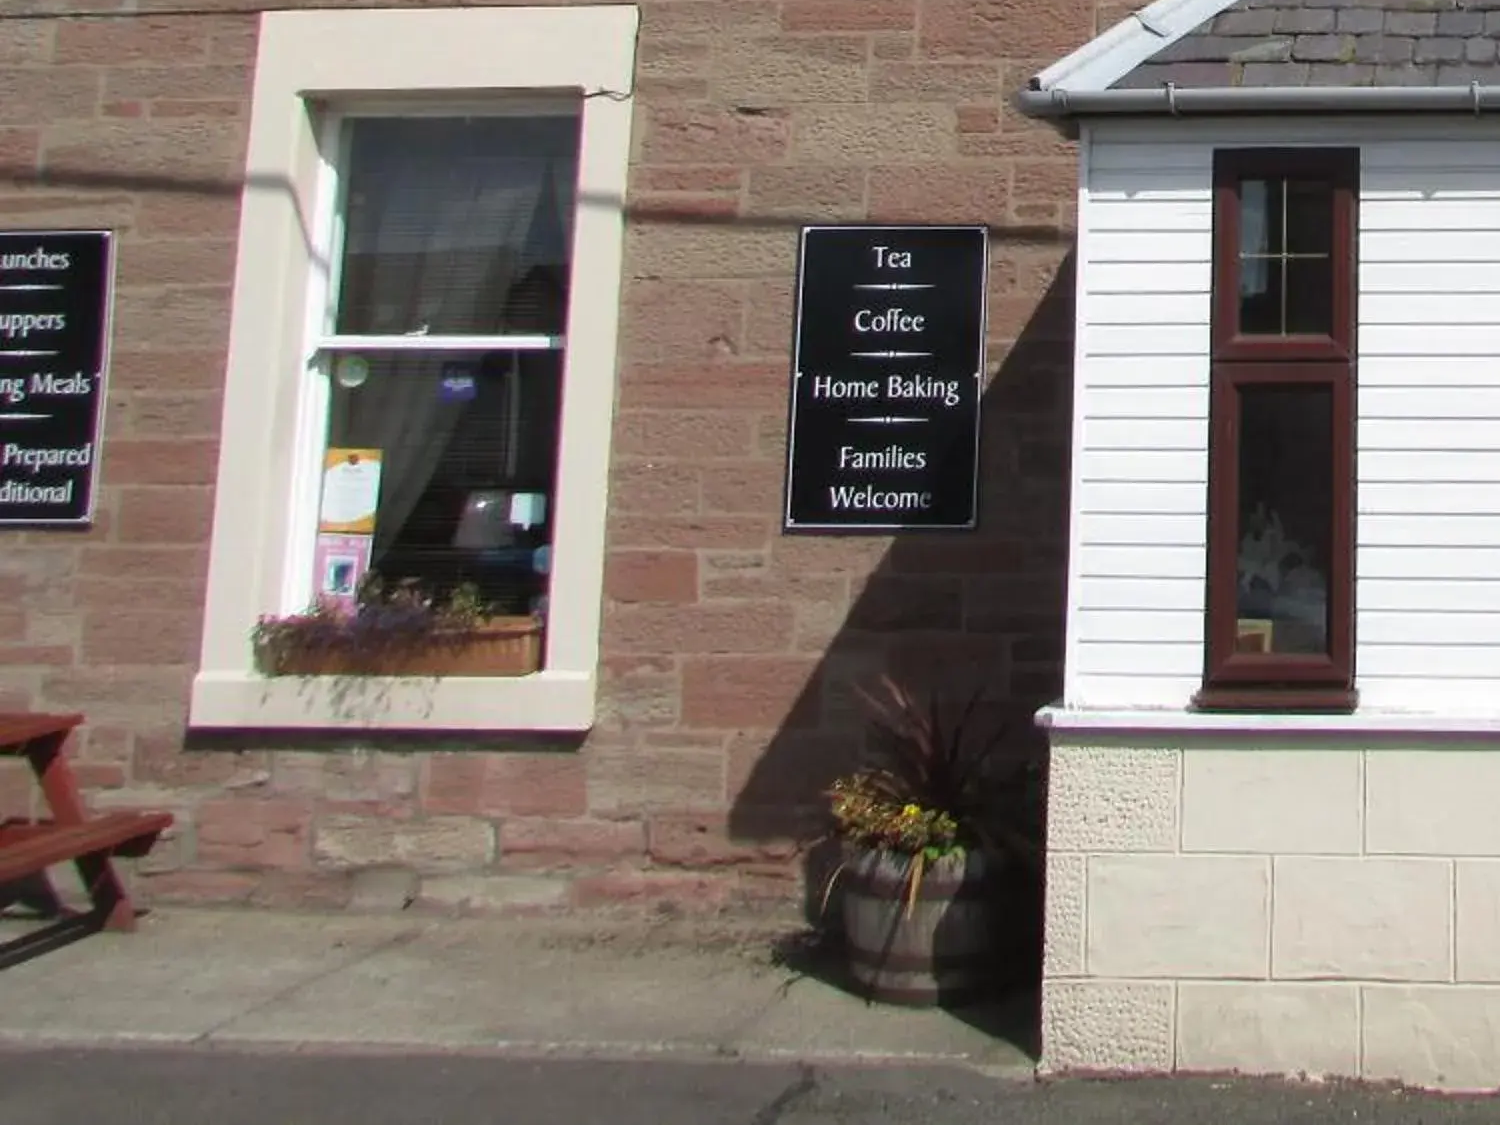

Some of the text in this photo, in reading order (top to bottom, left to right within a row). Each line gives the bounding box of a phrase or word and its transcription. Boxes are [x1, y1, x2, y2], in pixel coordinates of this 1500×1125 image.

[0, 246, 70, 269] unches
[872, 246, 912, 268] Tea
[0, 314, 66, 338] uppers
[854, 308, 925, 333] Coffee
[30, 371, 92, 394] Meals
[813, 376, 960, 406] Home Baking
[3, 442, 92, 473] Prepared
[839, 445, 927, 469] Families
[0, 478, 74, 503] ditional
[830, 486, 932, 509] Welcome
